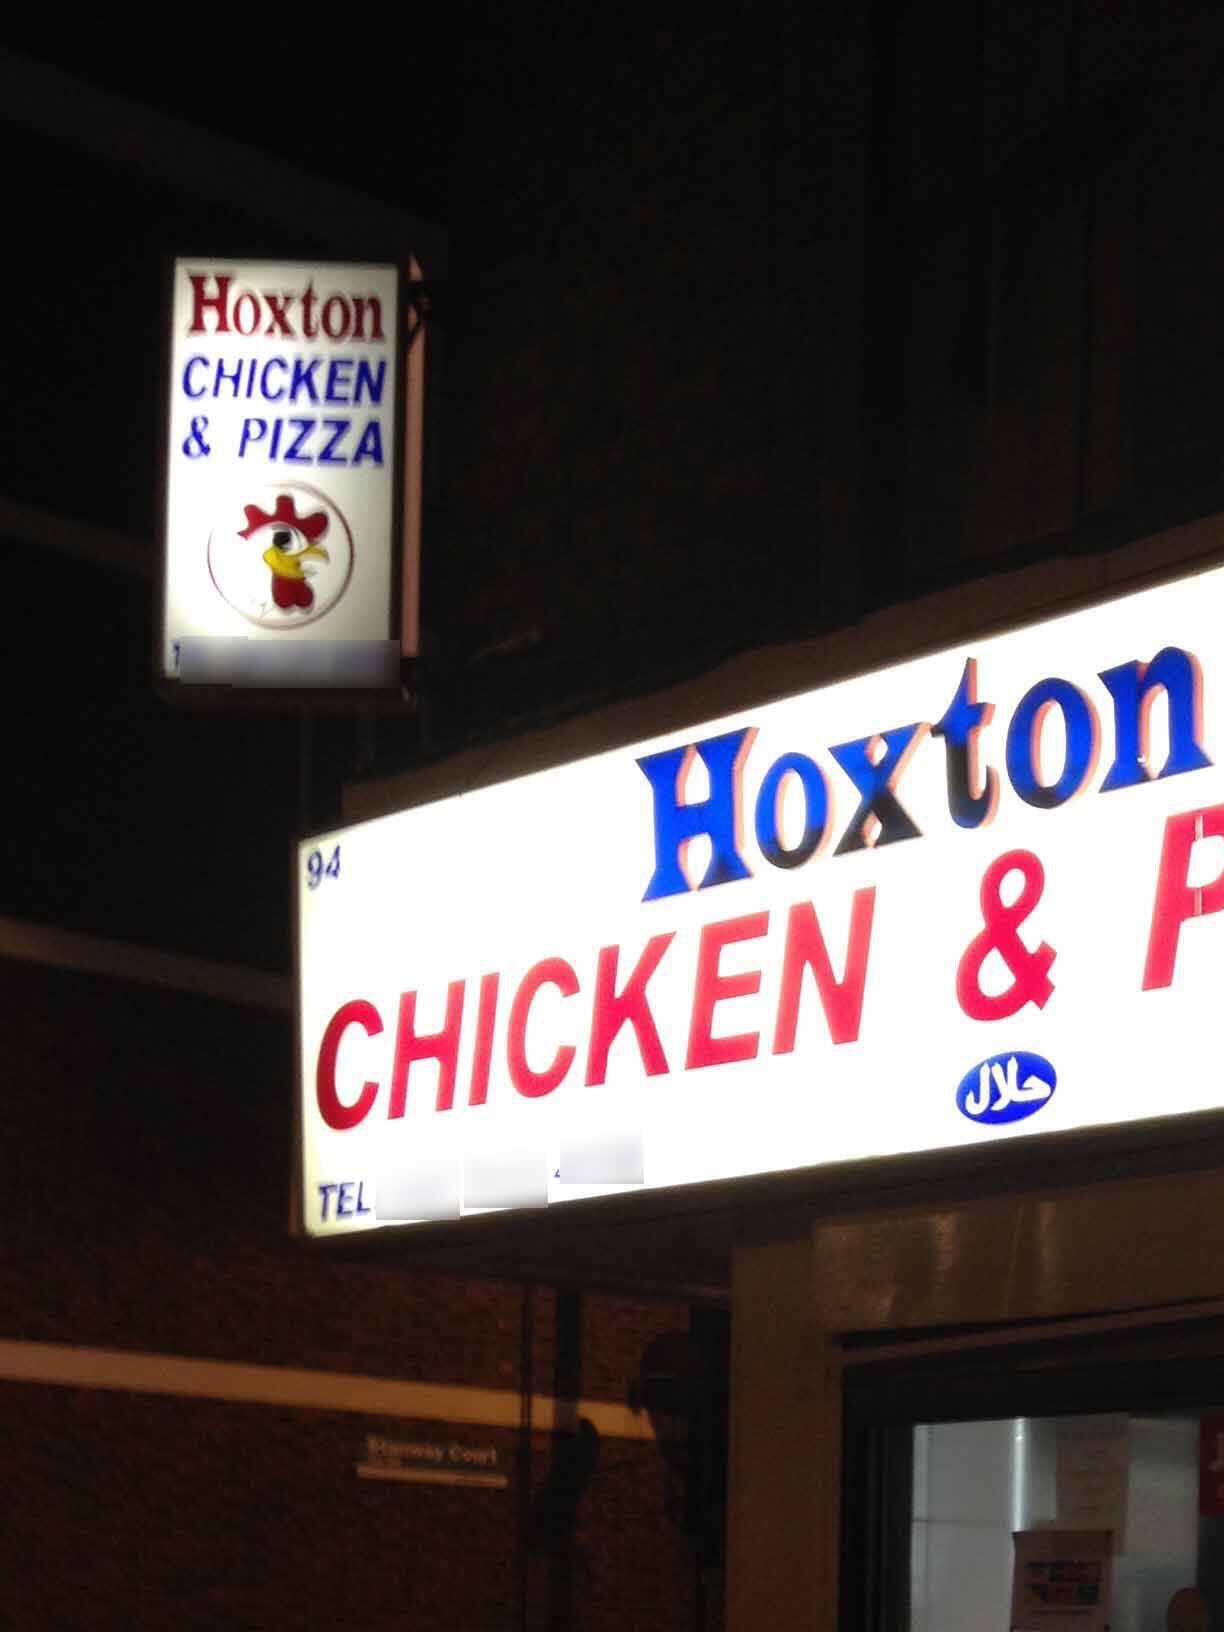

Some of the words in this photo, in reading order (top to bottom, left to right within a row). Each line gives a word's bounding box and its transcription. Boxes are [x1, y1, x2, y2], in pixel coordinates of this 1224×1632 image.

[188, 270, 385, 343] Hoxton
[183, 356, 387, 407] CHICKEN
[182, 415, 212, 459] &
[239, 417, 385, 467] PIZZA
[637, 645, 1214, 901] Hoxton
[306, 845, 341, 889] 94
[317, 887, 876, 1131] CHICKEN
[957, 849, 1057, 1022] &
